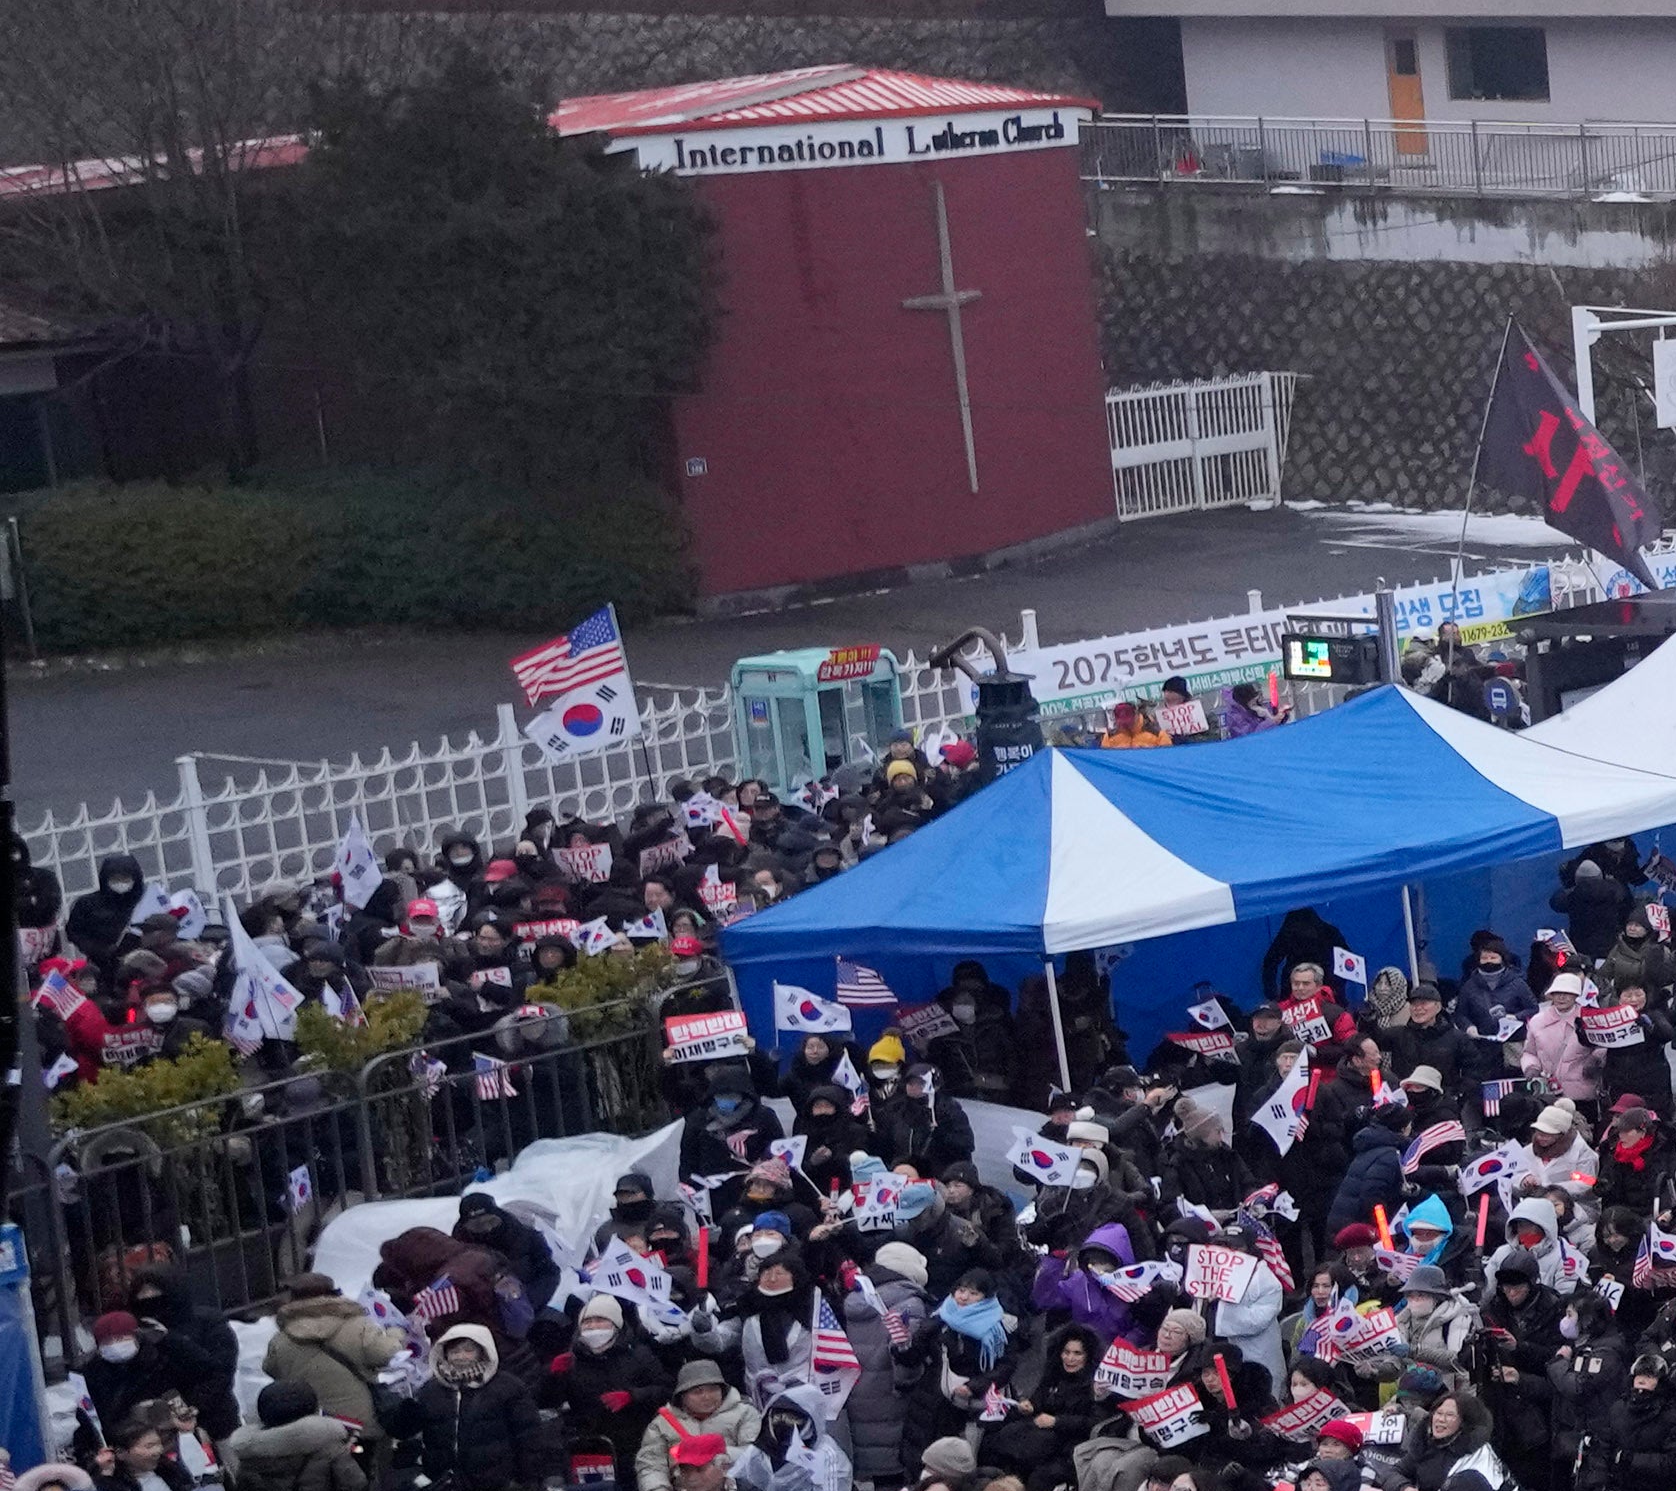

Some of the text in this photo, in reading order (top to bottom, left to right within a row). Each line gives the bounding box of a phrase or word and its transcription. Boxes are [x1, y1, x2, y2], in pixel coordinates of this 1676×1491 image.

[675, 112, 1064, 170] International Lutheran Church
[1163, 705, 1196, 720] STOP
[669, 1014, 747, 1042] 탄핵반대
[1197, 1250, 1244, 1267] STOP
[1202, 1266, 1231, 1282] THE
